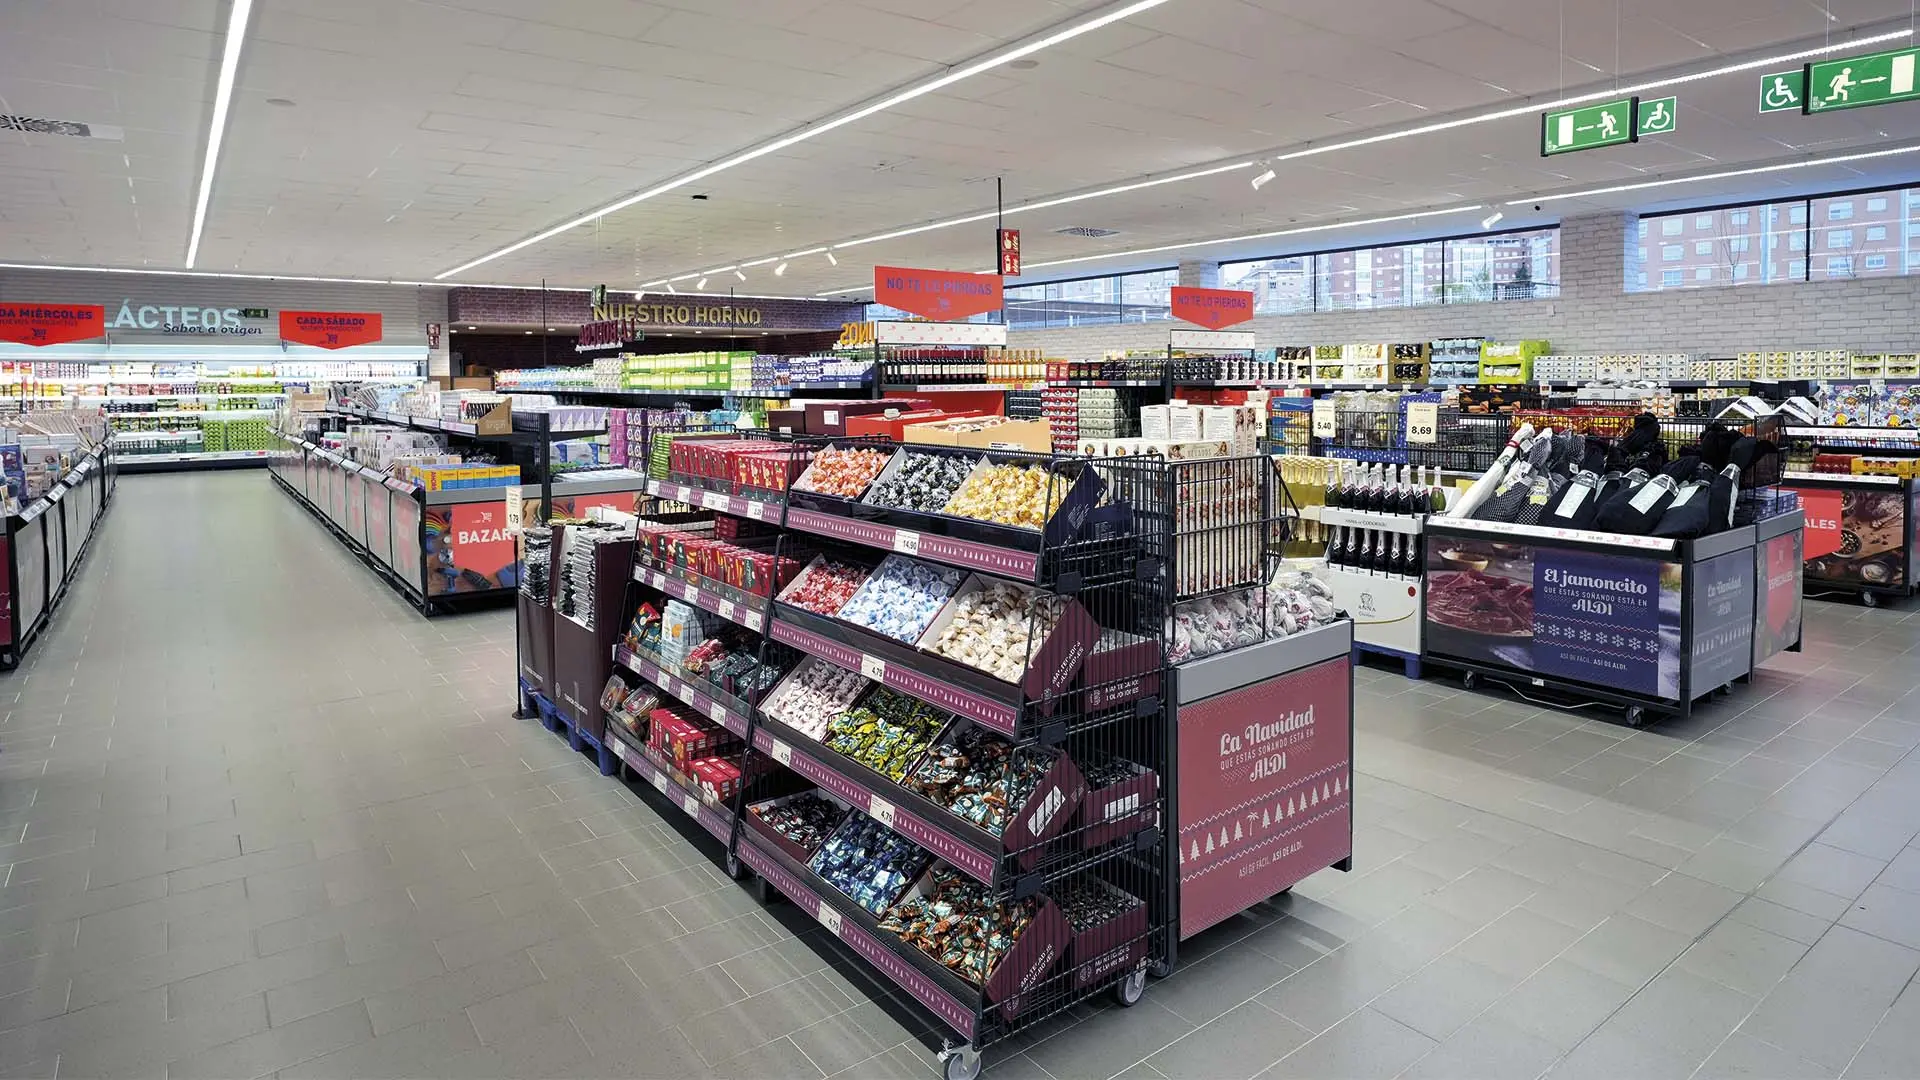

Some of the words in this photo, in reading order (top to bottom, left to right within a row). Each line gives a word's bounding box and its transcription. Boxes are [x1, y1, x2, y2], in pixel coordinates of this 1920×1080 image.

[887, 278, 904, 290] NO
[908, 279, 921, 292] TE
[944, 281, 993, 295] PIERDAS
[1178, 296, 1189, 305] NO
[1191, 296, 1200, 306] TE
[1203, 297, 1212, 307] LO
[1215, 297, 1246, 309] PIERDAS
[20, 308, 93, 319] MIÉRCOLES
[104, 299, 241, 329] ÁCTEOS
[297, 317, 323, 325] CADA
[327, 315, 365, 325] SÁBADO
[593, 304, 690, 323] NUESTRO
[695, 306, 761, 323] HORNO
[164, 323, 202, 334] Sabor
[208, 326, 216, 334] a
[221, 326, 263, 336] origen
[1317, 421, 1331, 430] 5,40
[1411, 425, 1431, 435] 8,69
[458, 528, 513, 544] BAZAR
[1544, 568, 1559, 583] El
[1560, 570, 1648, 595] jamoncito
[1544, 586, 1556, 594] QUE
[1582, 591, 1615, 602] SOÑANDO
[1638, 599, 1648, 607] EN
[1358, 605, 1376, 613] ANNA
[1572, 598, 1612, 616] ALDI
[1604, 660, 1611, 668] DE
[1220, 733, 1242, 756] La
[1245, 704, 1315, 746] Navidad
[1221, 757, 1233, 770] QUE
[1258, 737, 1288, 757] SOÑANDO
[1306, 727, 1314, 738] EN
[1249, 751, 1286, 782] ALDI
[881, 810, 892, 823] 4,79
[1272, 848, 1282, 863] ASÍ
[1283, 846, 1289, 857] DE
